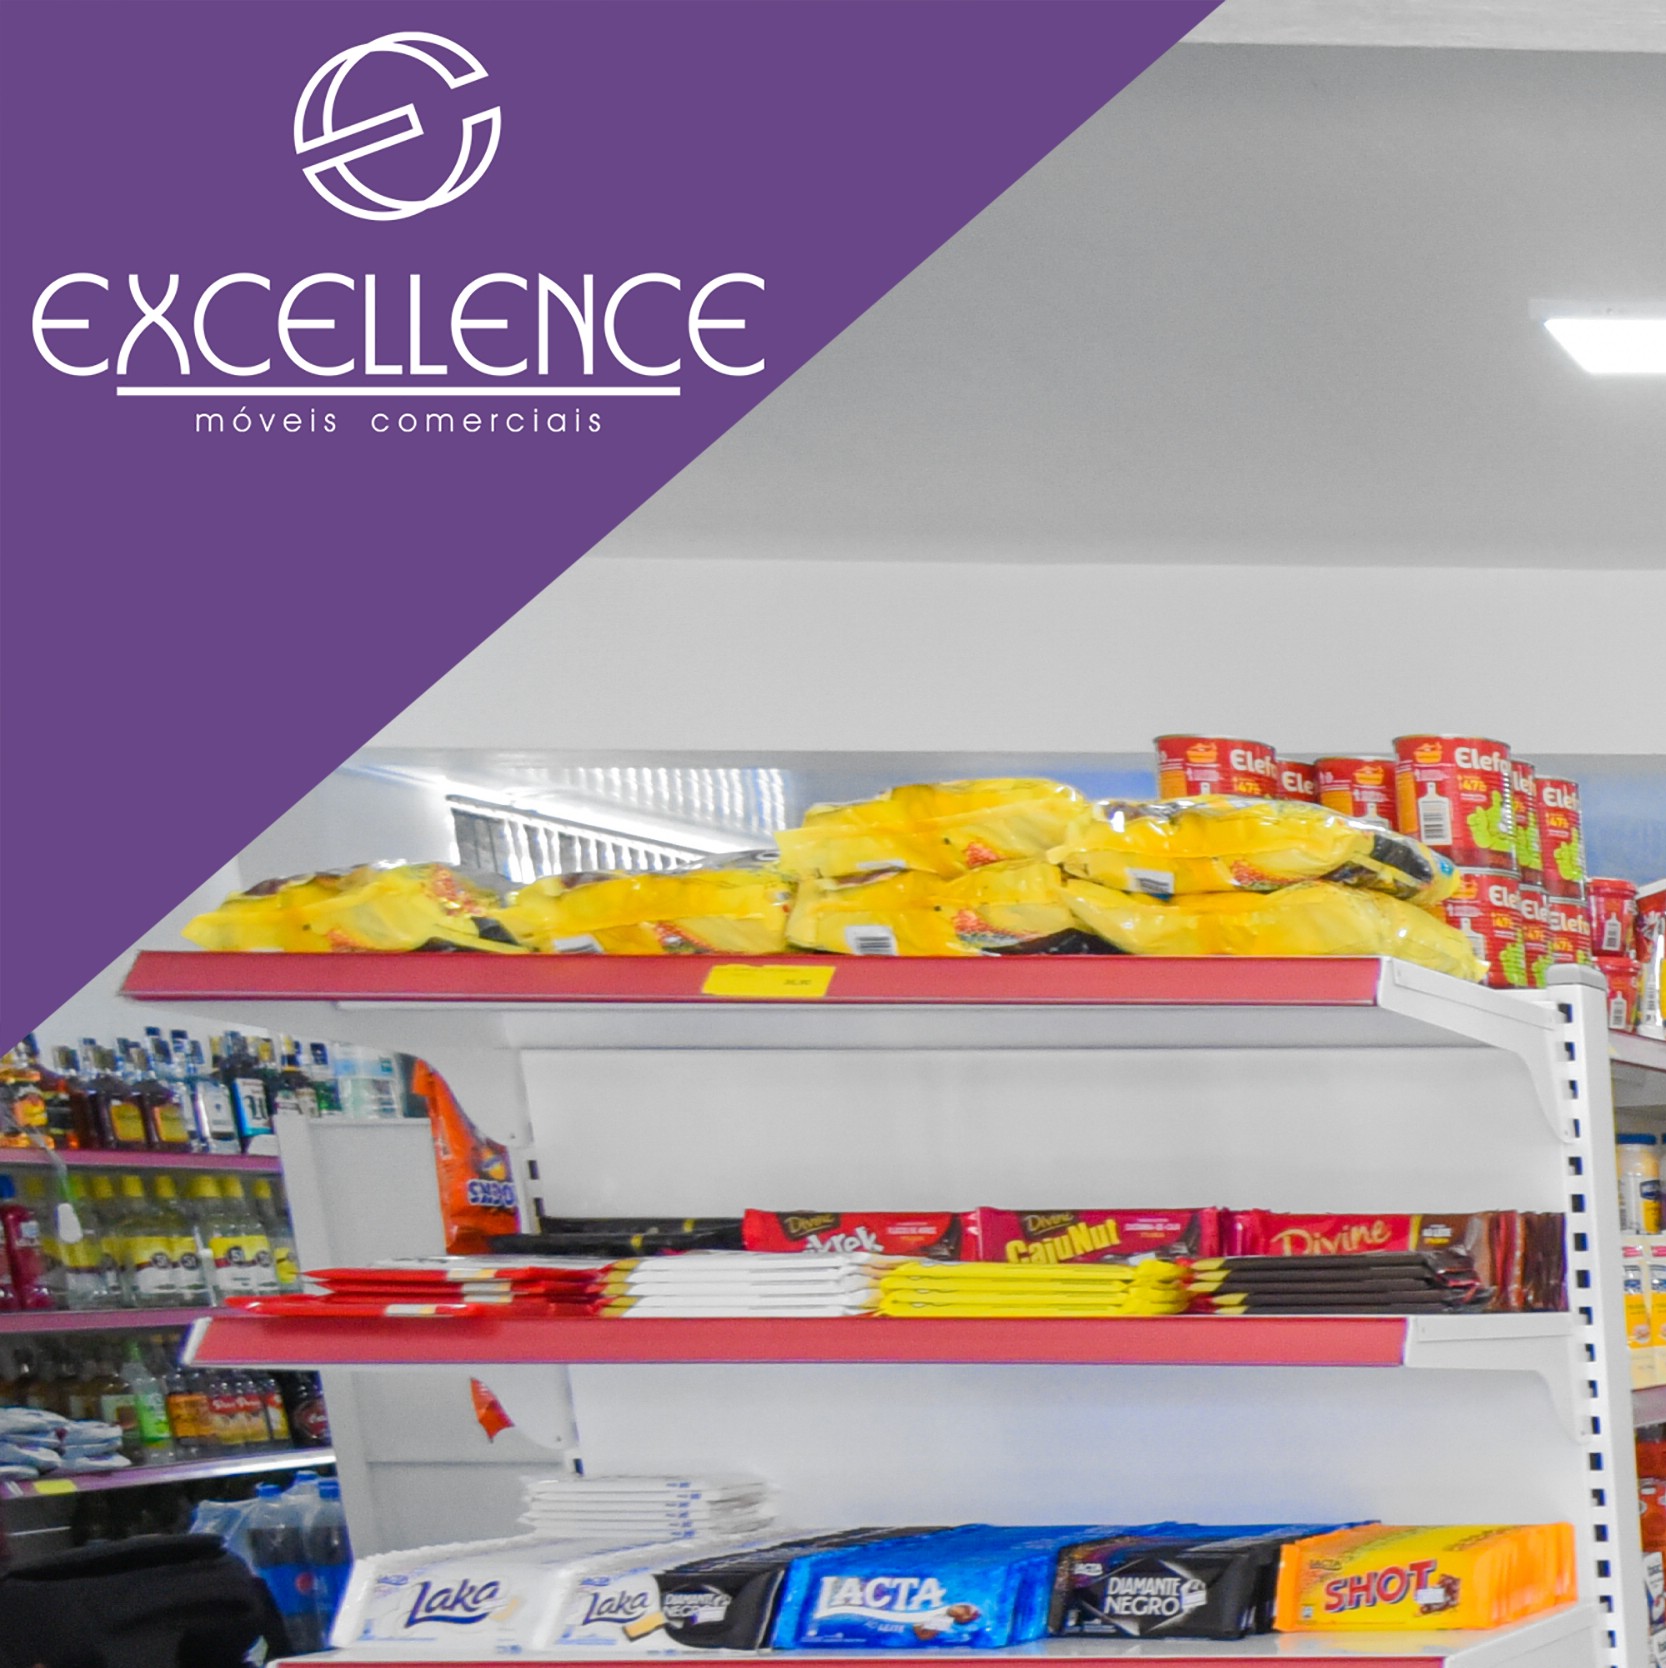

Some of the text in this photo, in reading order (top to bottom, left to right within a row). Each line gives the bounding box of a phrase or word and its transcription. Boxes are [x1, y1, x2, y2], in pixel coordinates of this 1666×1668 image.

[405, 1579, 500, 1629] Laka
[815, 1576, 946, 1612] LACTA
[1107, 1576, 1181, 1597] DIAMANTE
[1324, 1559, 1437, 1613] SHOT
[583, 1589, 650, 1626] Laka
[1104, 1596, 1180, 1617] NEGRO
